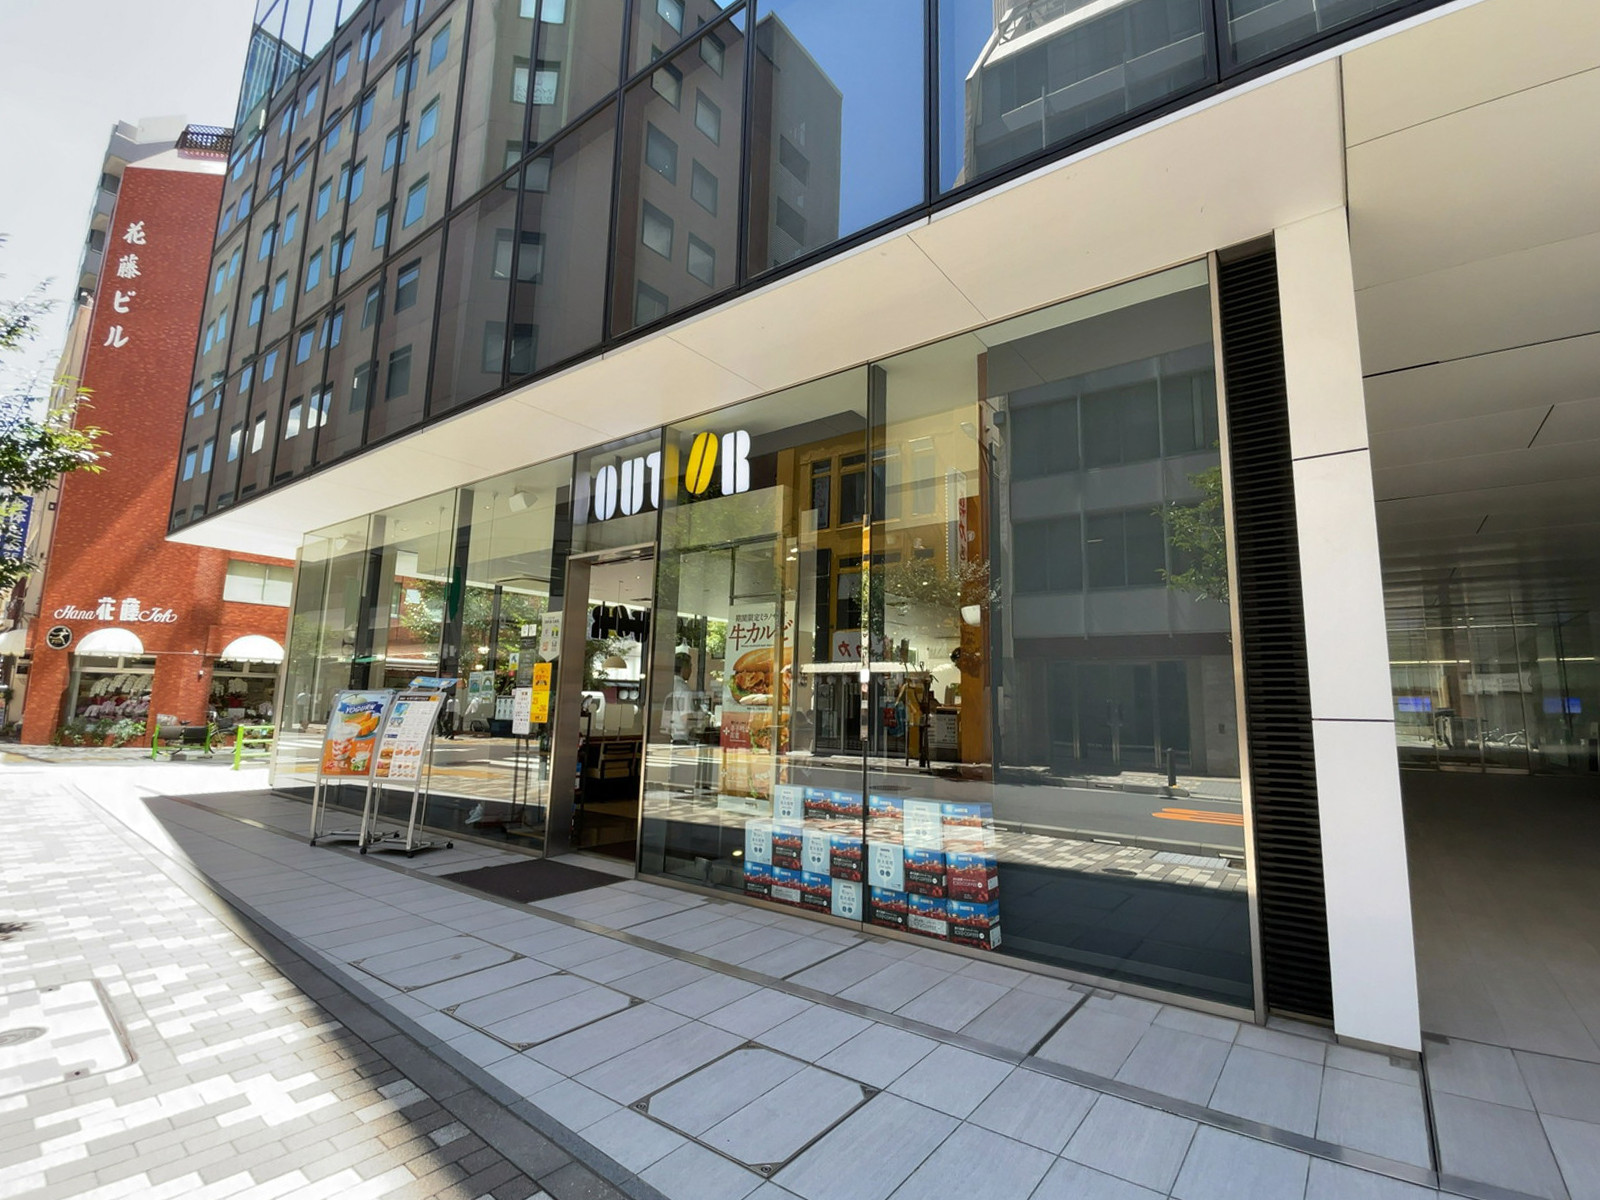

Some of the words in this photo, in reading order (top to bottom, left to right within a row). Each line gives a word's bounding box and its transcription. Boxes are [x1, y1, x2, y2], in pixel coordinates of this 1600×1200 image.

[104, 221, 147, 348] 花藤ビル
[53, 605, 96, 620] Hana
